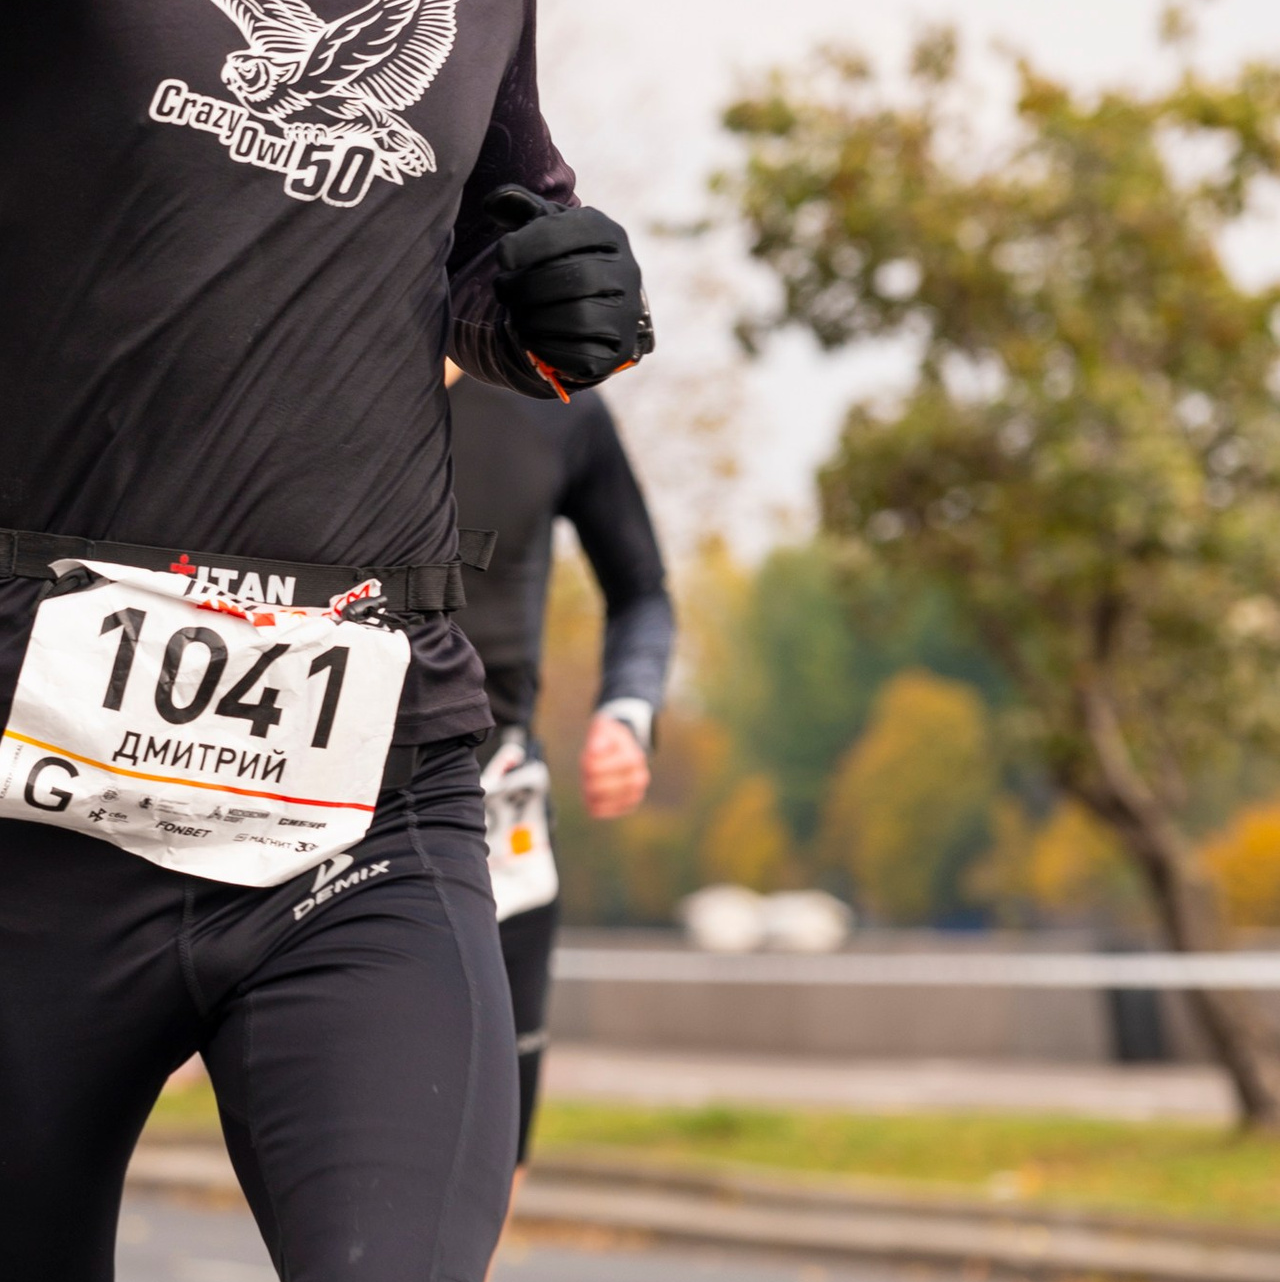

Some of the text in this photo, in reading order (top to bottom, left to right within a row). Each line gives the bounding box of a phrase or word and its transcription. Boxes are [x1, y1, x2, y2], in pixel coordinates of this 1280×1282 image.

[152, 81, 247, 141] Crazy
[232, 121, 297, 172] Owl
[287, 138, 377, 204] 50
[99, 607, 350, 749] 1041
[24, 756, 79, 812] G
[112, 731, 289, 783] ДМИТРИЙ
[155, 820, 212, 838] FONBET
[293, 860, 391, 920] DEMIX
